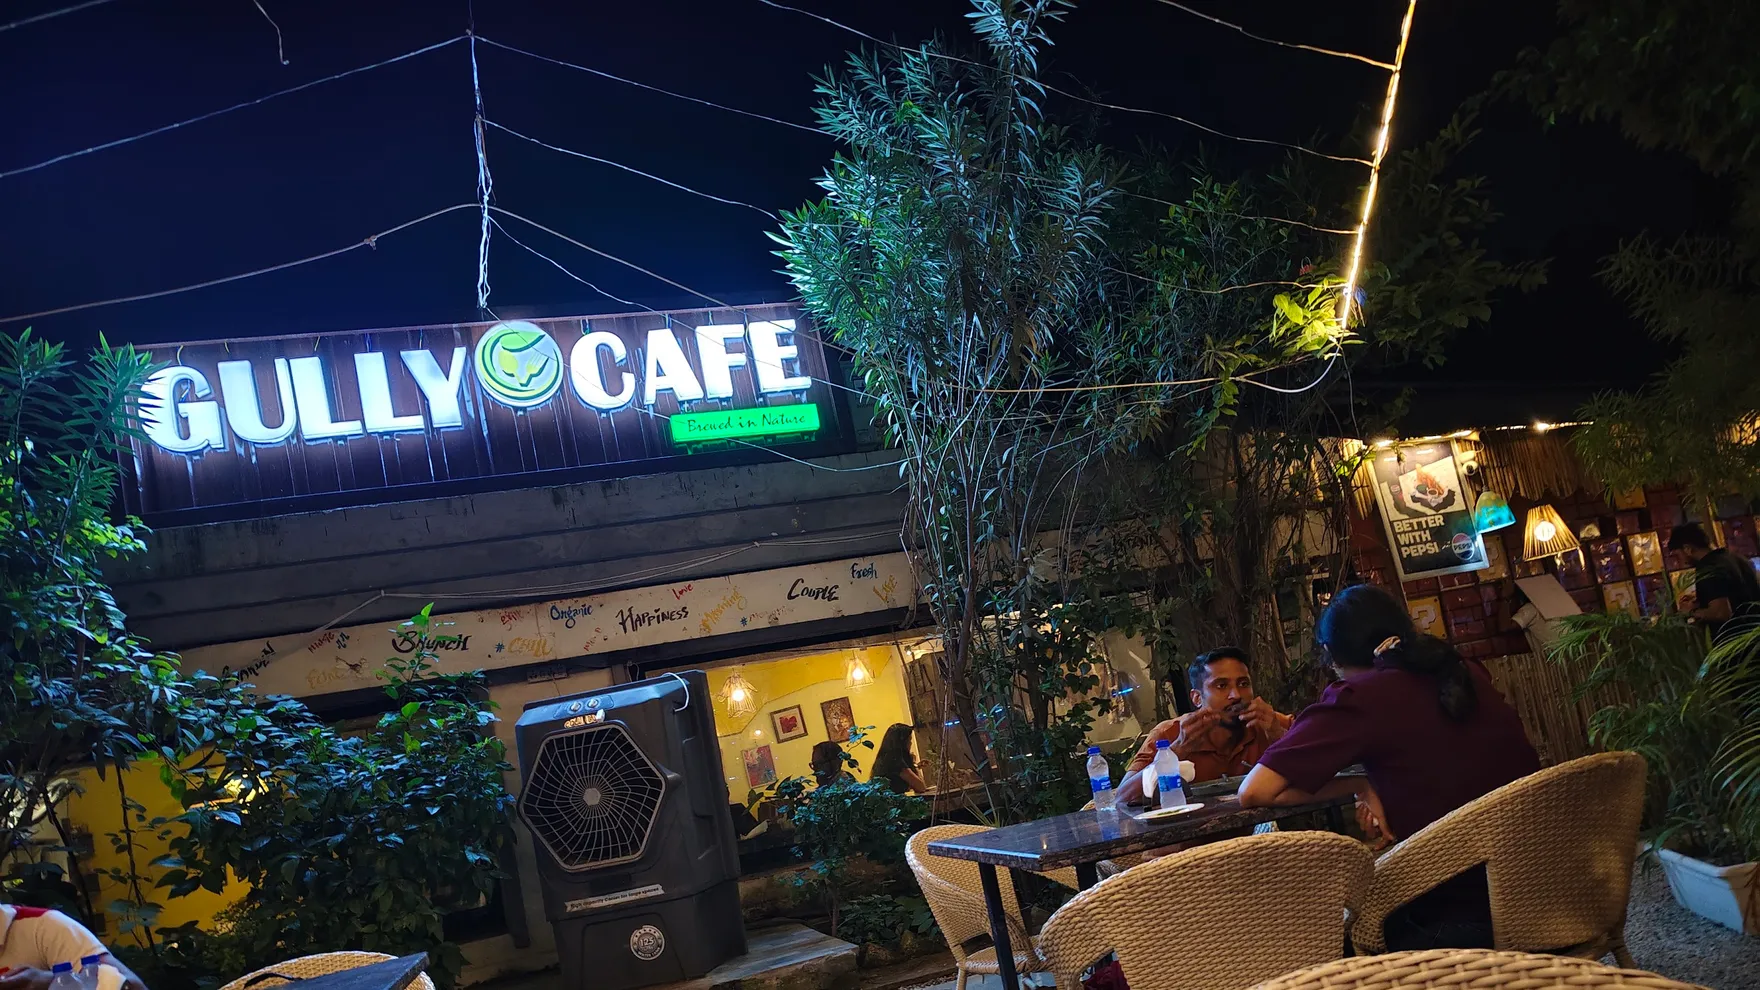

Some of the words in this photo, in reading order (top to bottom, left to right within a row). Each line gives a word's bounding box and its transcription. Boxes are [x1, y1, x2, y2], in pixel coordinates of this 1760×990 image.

[138, 346, 466, 454] GULLY
[570, 319, 812, 410] CAFE
[738, 416, 757, 428] in
[762, 414, 806, 426] Nature
[1394, 514, 1445, 532] BETTER
[1397, 529, 1432, 545] WITH
[1400, 541, 1440, 559] PEPSI
[850, 562, 878, 579] Fresh
[672, 583, 694, 600] Love
[550, 604, 593, 629] Organic
